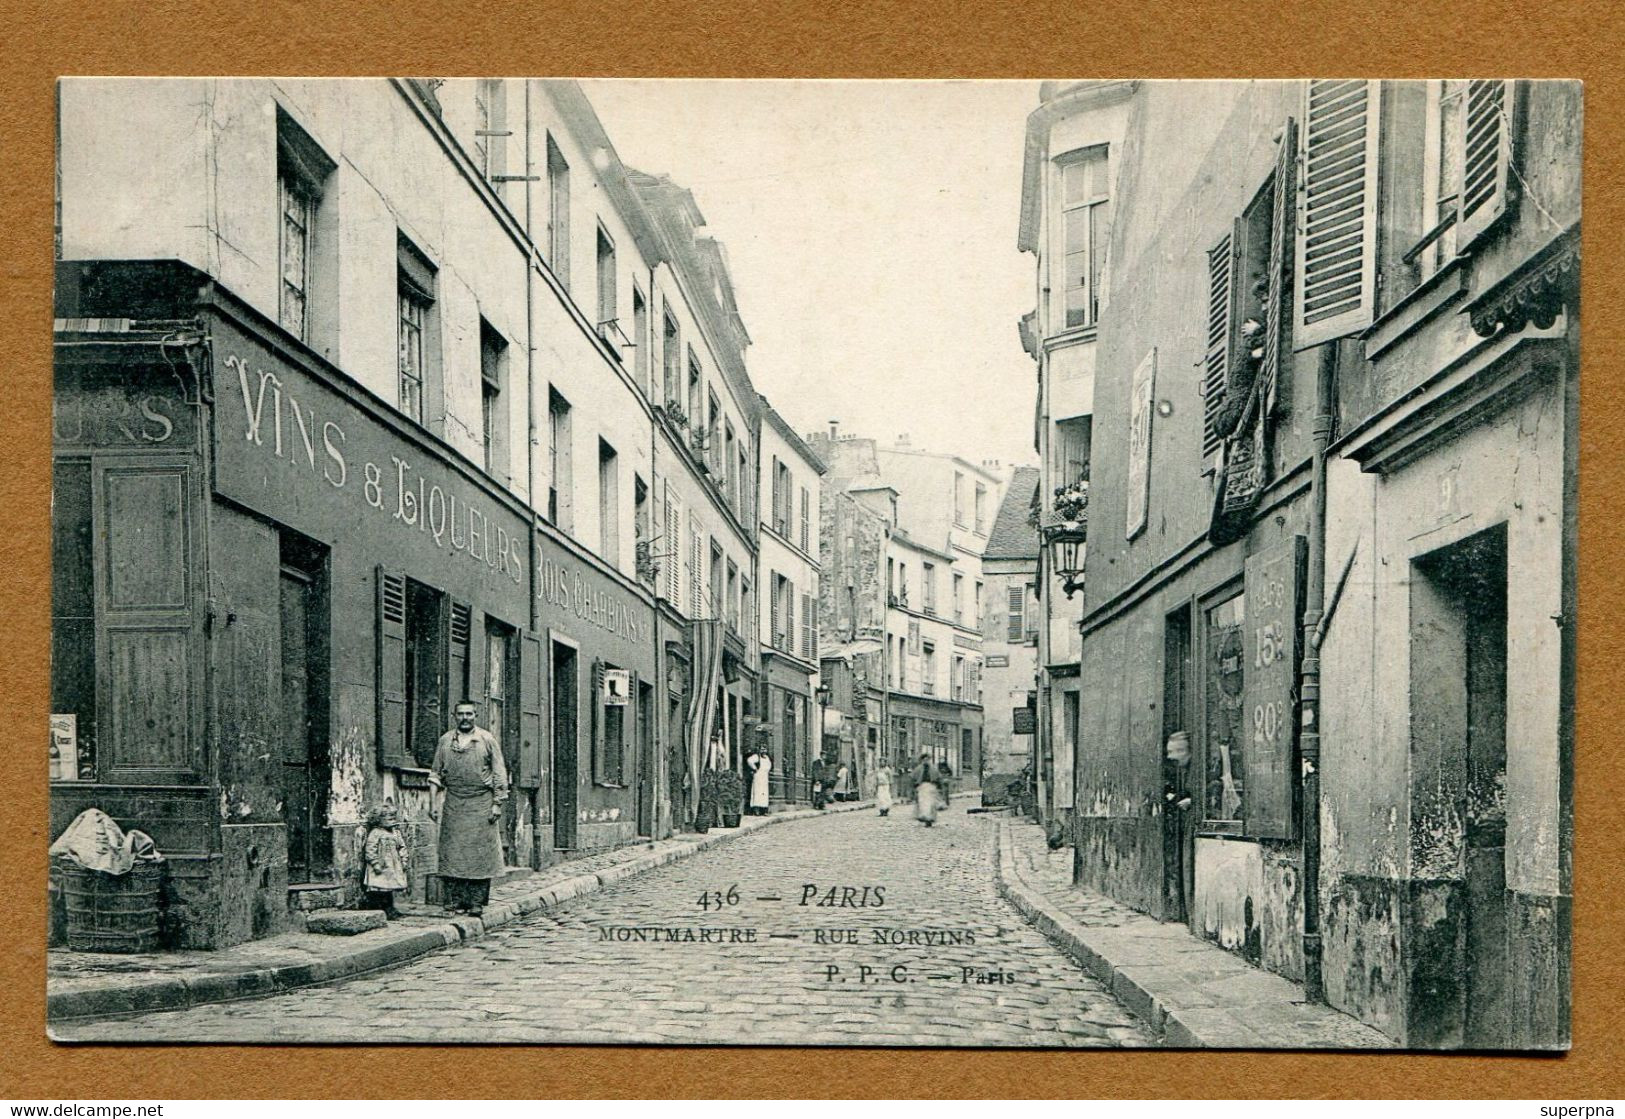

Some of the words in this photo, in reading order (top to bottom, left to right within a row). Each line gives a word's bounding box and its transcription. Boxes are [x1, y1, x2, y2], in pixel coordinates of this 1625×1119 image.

[223, 354, 346, 488] VINS
[364, 462, 384, 510] &
[392, 455, 522, 584] LIQUEURS
